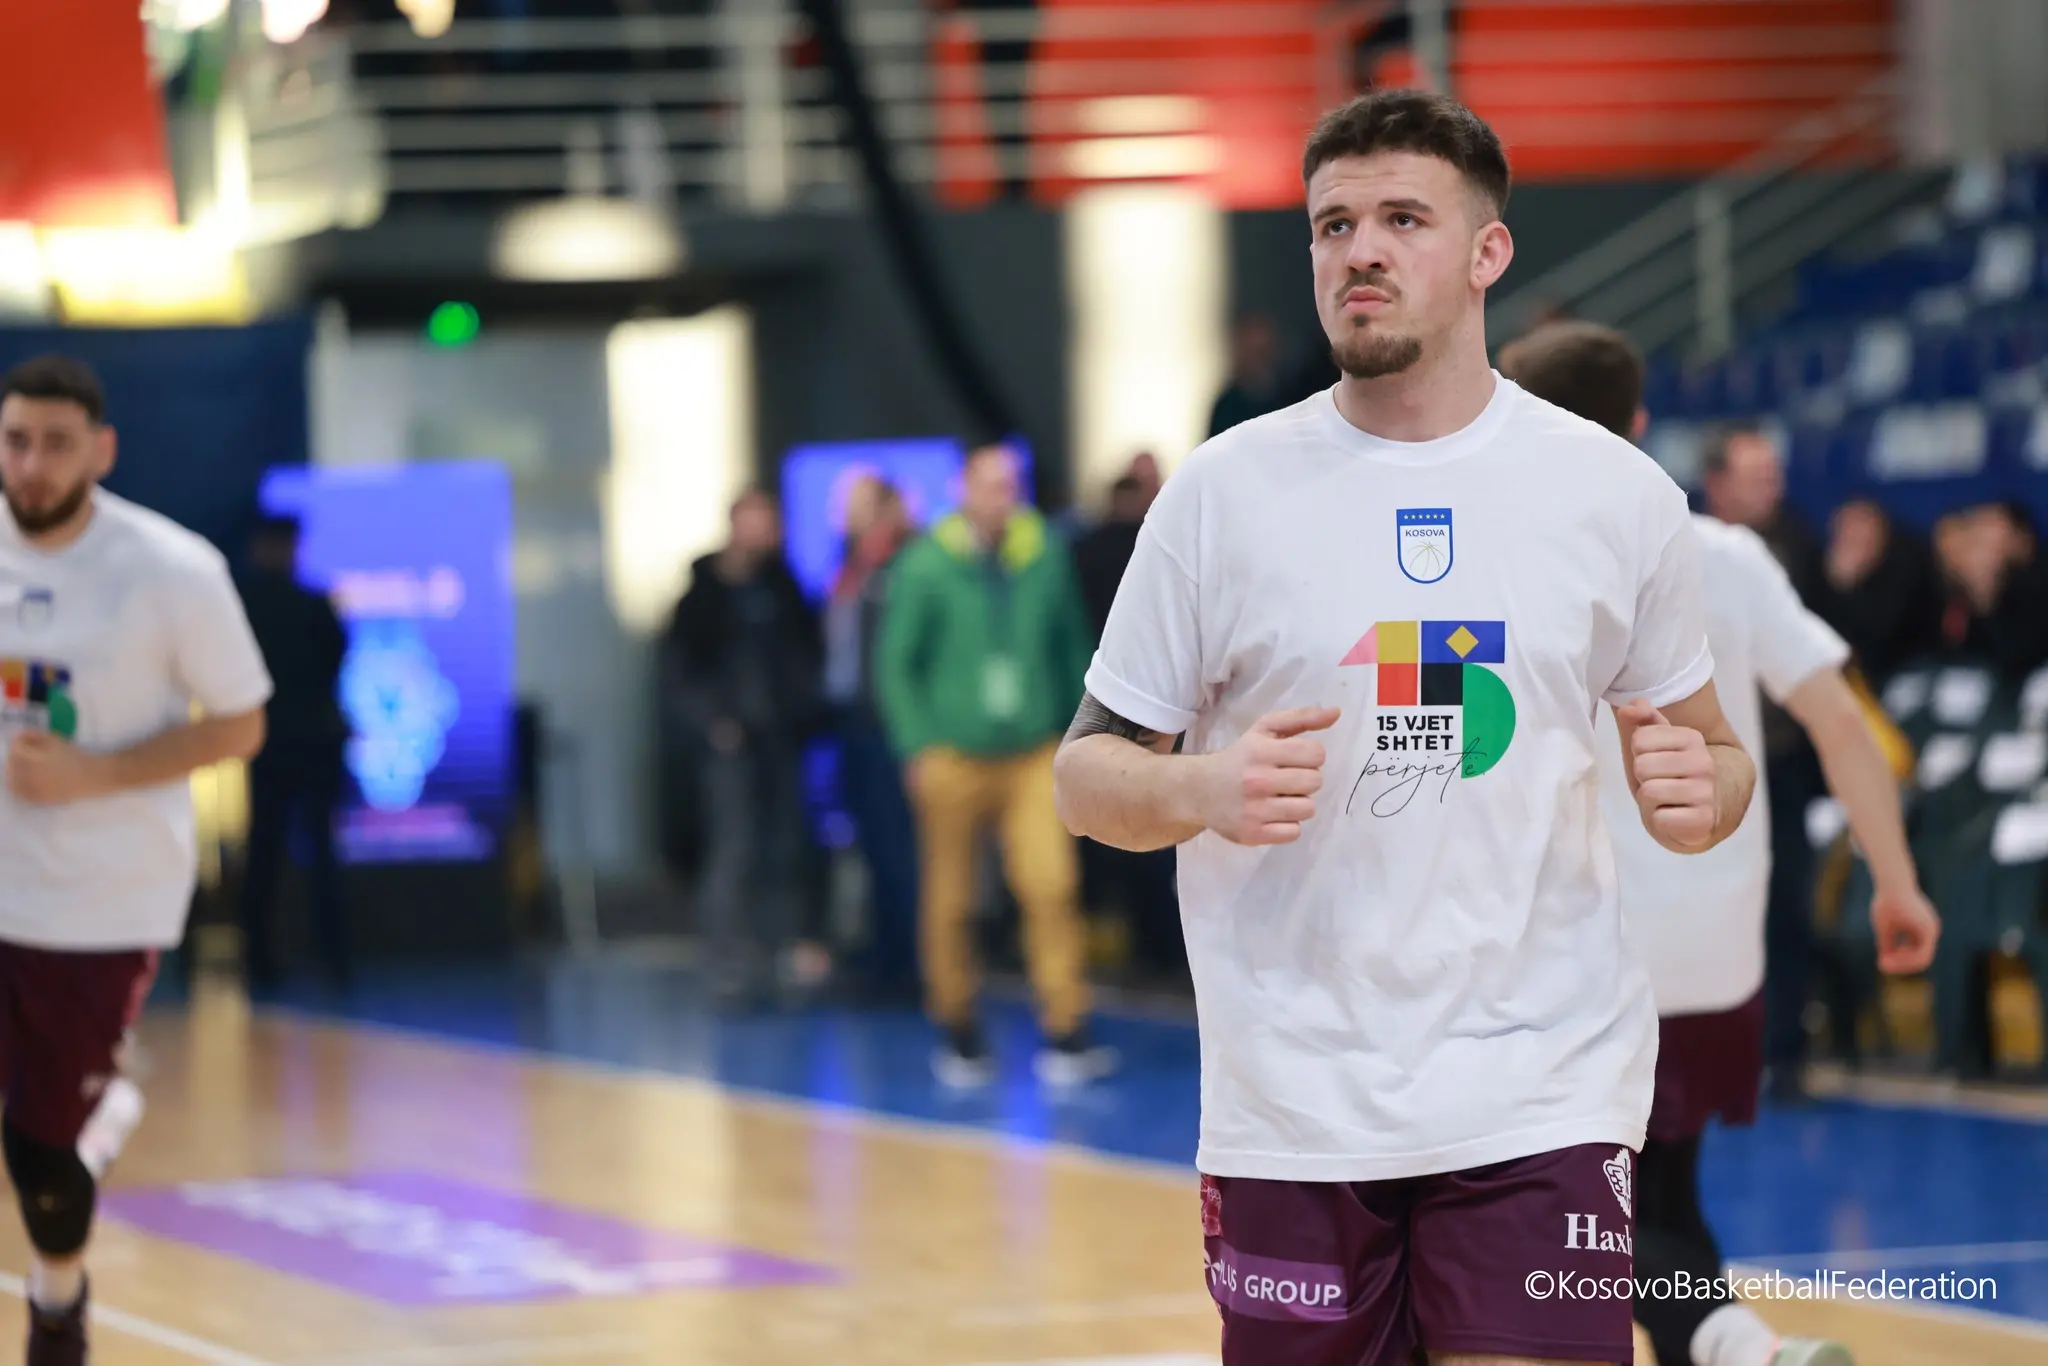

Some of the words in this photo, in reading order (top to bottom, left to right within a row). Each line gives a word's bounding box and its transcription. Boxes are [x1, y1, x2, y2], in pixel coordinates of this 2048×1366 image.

[1405, 529, 1445, 537] KOSOVA
[1376, 715, 1398, 731] 15
[1404, 715, 1454, 731] VJET
[1376, 735, 1454, 751] SHTET
[1345, 737, 1487, 818] përjetë
[1244, 1274, 1342, 1306] GROUP
